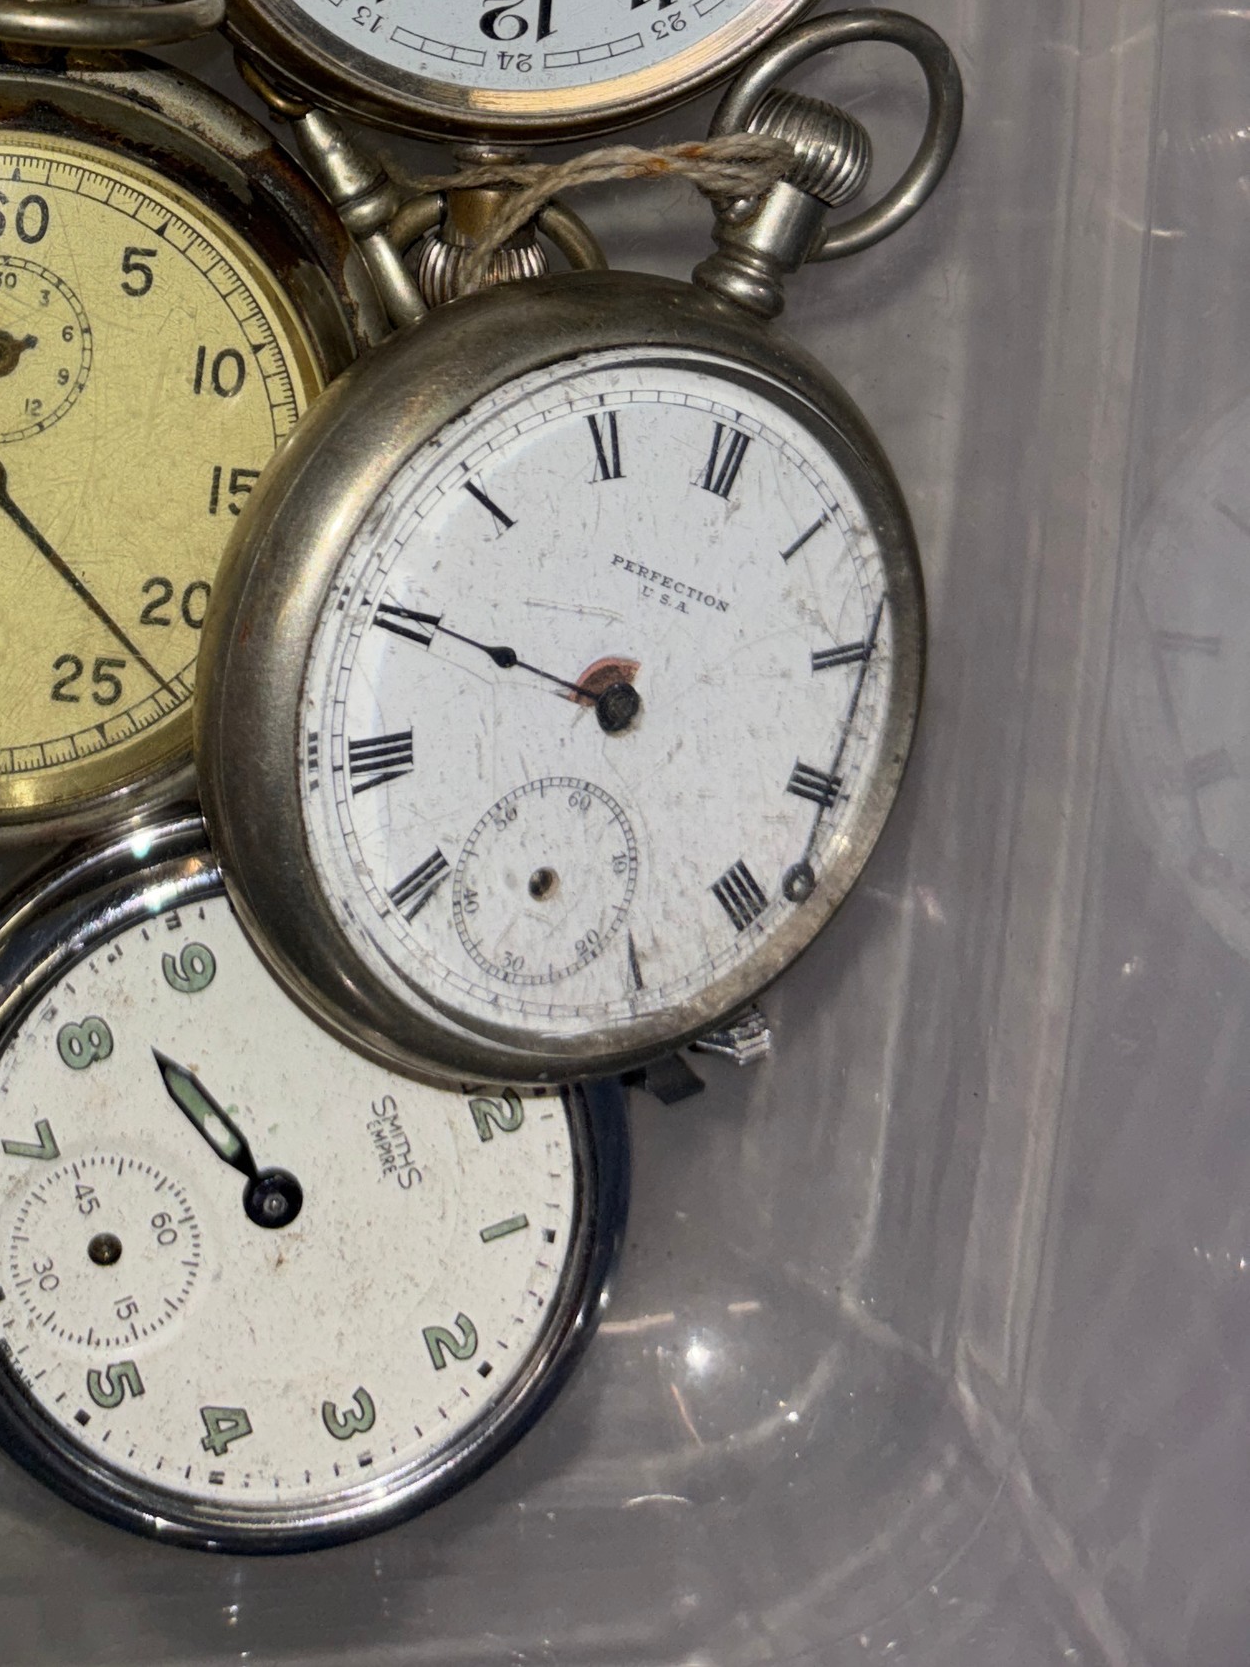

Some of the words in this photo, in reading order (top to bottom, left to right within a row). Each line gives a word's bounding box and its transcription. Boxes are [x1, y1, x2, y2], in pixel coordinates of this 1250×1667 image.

[350, 3, 389, 35] 13
[650, 10, 688, 42] 23
[497, 50, 533, 74] 24
[120, 247, 157, 298] 5
[38, 289, 50, 307] 3
[62, 325, 74, 342] 6
[57, 368, 70, 385] 9
[192, 345, 246, 398] 10
[25, 398, 43, 416] 12
[208, 466, 260, 516] 15
[140, 576, 211, 629] 20
[610, 554, 730, 612] PERFECTION
[50, 654, 126, 706] 25
[568, 788, 593, 813] 60
[461, 888, 480, 916] 40
[161, 940, 218, 993] 9
[501, 950, 526, 972] 30
[56, 1015, 114, 1070] 8
[1, 1119, 61, 1162] 7
[366, 1121, 397, 1178] EMPIRE
[371, 1094, 422, 1190] SMITHS
[75, 1184, 101, 1215] 45
[150, 1210, 178, 1247] 60
[33, 1257, 60, 1292] 30
[113, 1295, 139, 1321] 15
[421, 1312, 479, 1370] 2
[86, 1359, 146, 1409] 5
[199, 1405, 253, 1456] 4
[321, 1385, 377, 1441] 3
